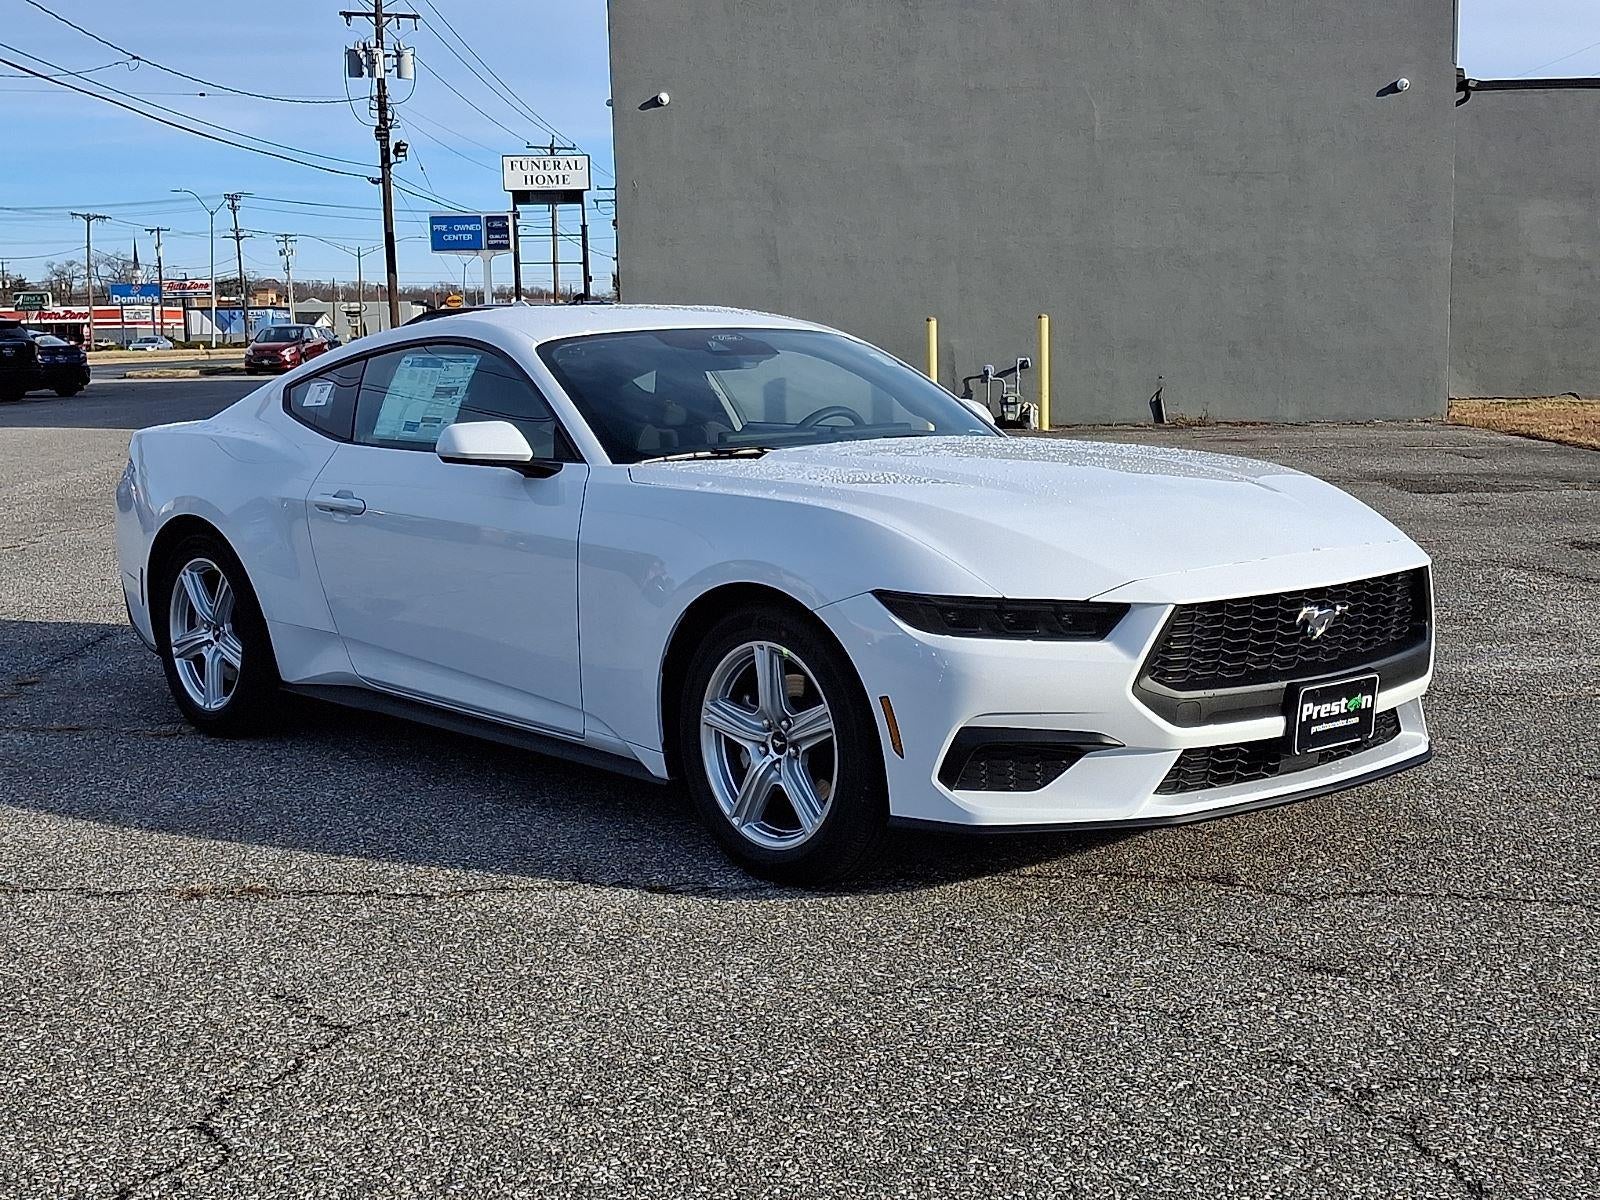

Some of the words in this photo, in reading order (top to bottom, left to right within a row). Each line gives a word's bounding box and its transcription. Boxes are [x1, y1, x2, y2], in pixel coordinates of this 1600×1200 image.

[510, 160, 583, 171] FUNERAL
[524, 174, 571, 185] HOME
[433, 224, 448, 232] PRE
[166, 281, 209, 291] AutoZone
[112, 294, 160, 304] Domino's
[1301, 693, 1373, 722] Preston
